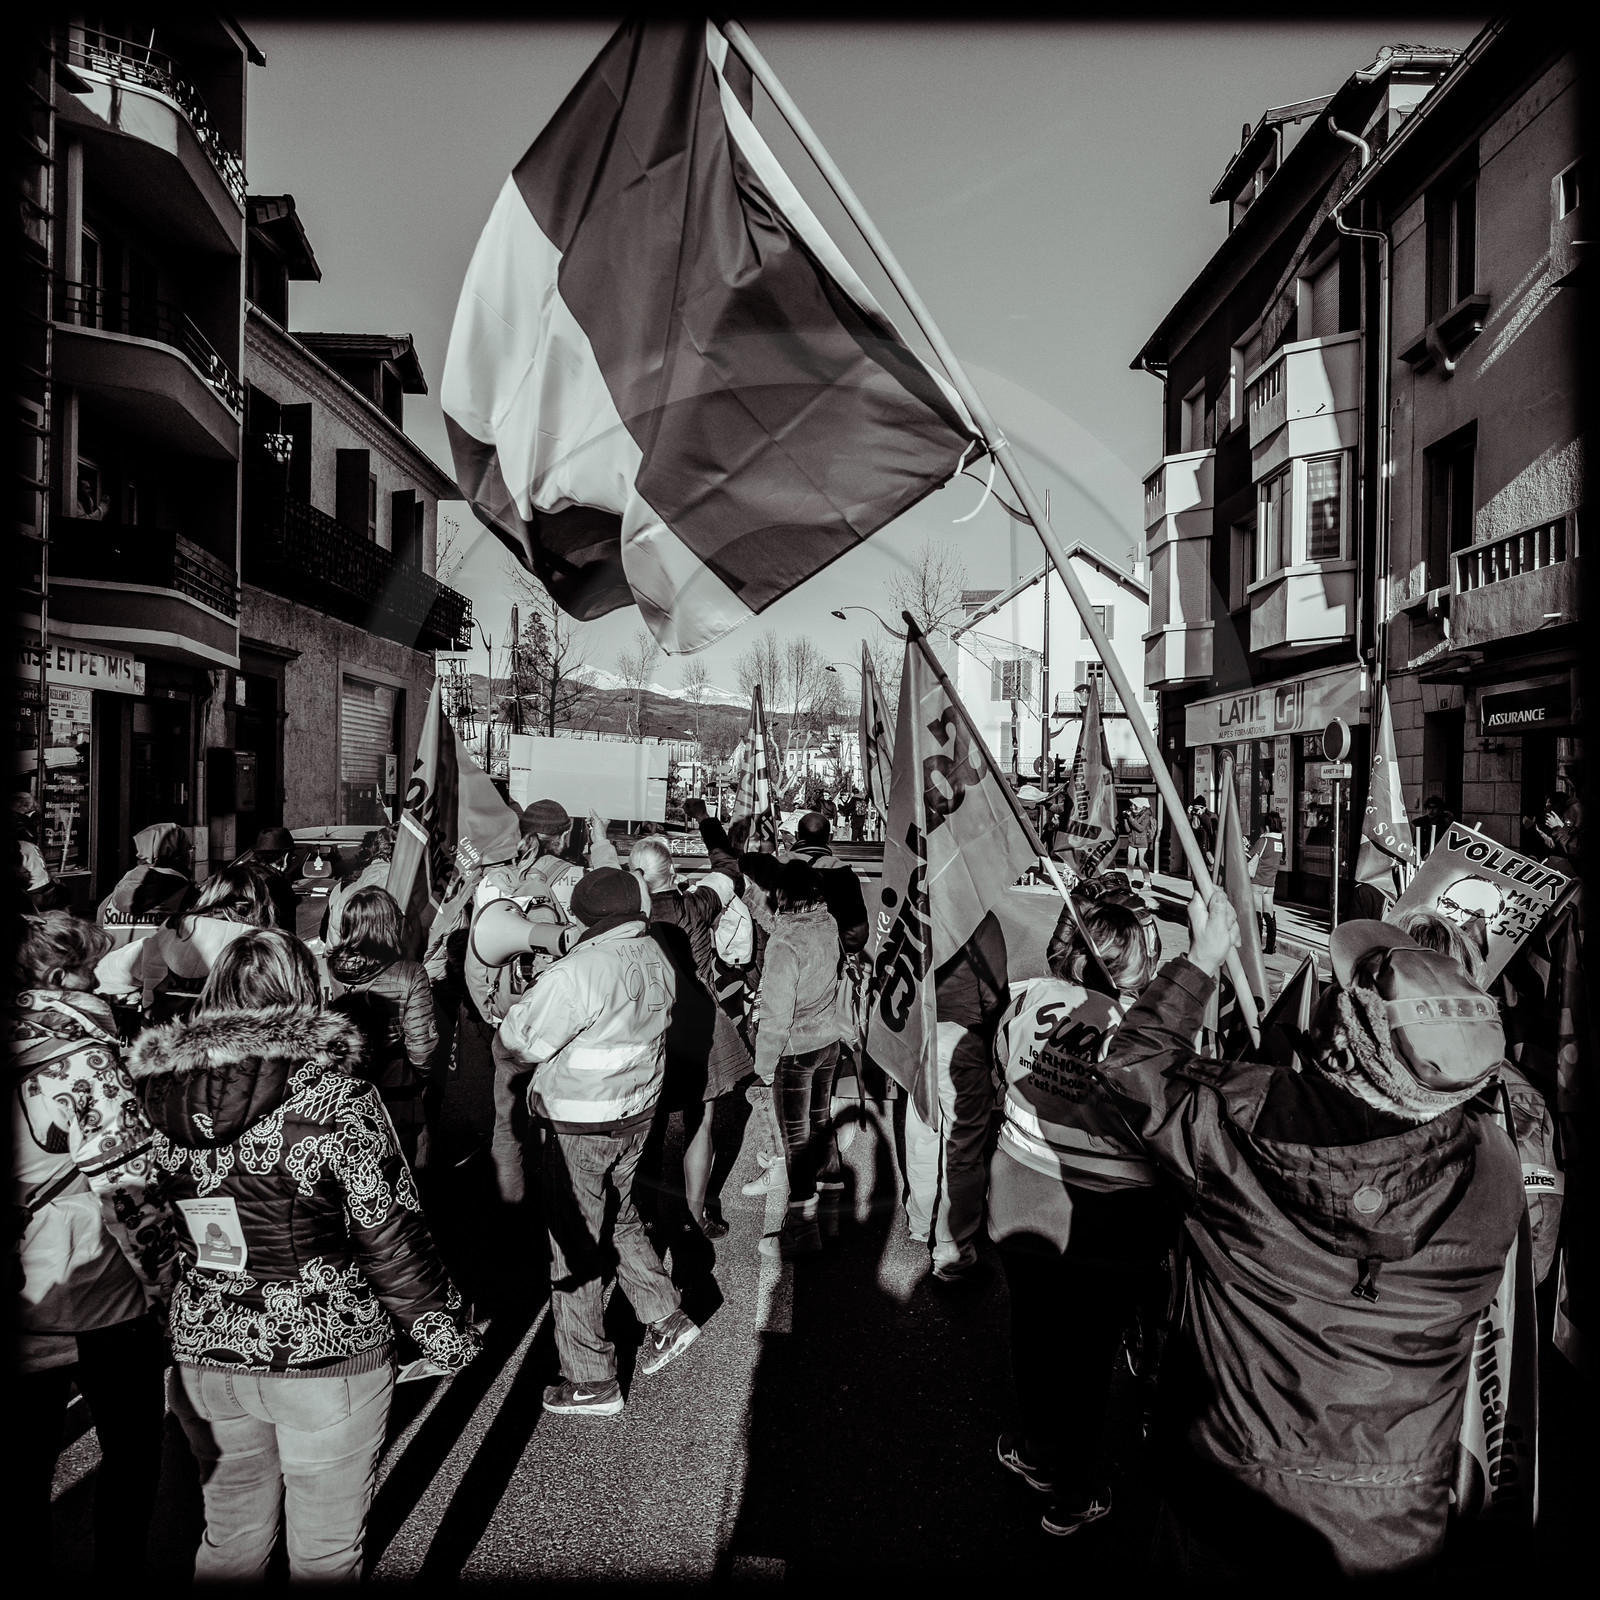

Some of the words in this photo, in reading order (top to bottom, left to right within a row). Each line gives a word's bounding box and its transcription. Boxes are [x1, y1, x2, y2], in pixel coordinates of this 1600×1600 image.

[57, 646, 75, 672] ET
[1219, 694, 1266, 727] LATIL
[1488, 707, 1546, 726] ASSURANCE
[1218, 730, 1234, 739] ALPES
[459, 836, 481, 865] Union
[1447, 831, 1567, 902] VOLEUR
[1501, 906, 1539, 930] PAS
[625, 961, 668, 1012] 05
[1029, 1045, 1039, 1060] le
